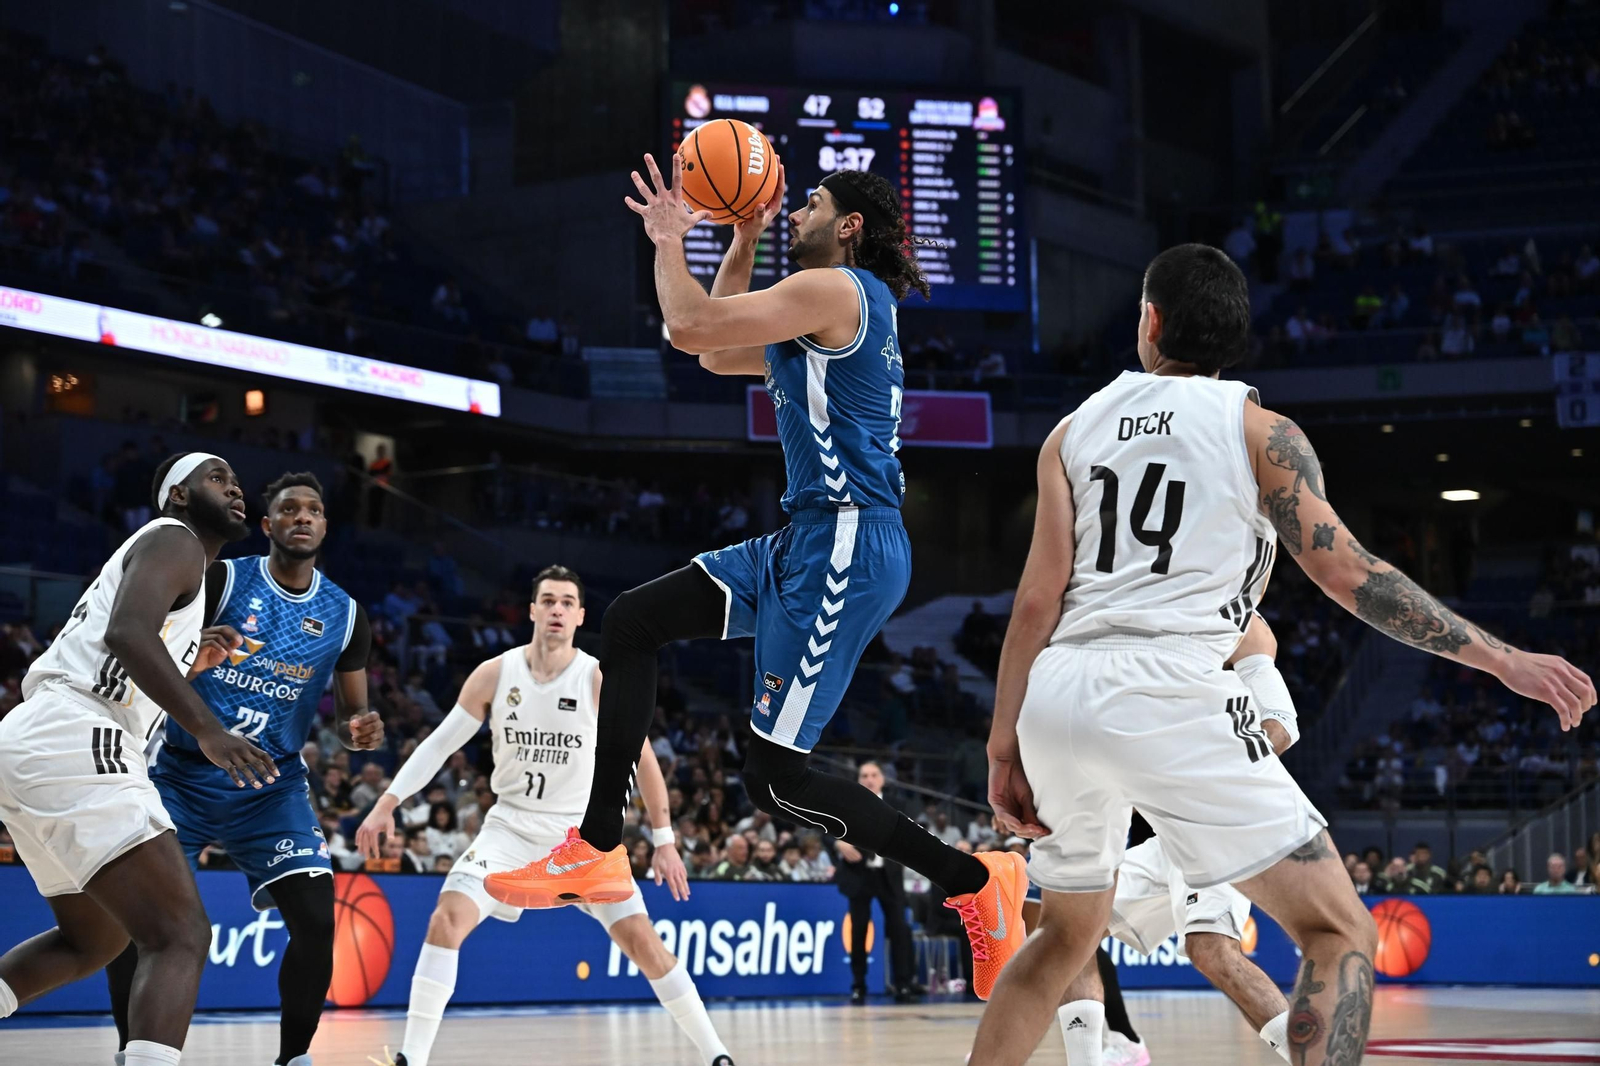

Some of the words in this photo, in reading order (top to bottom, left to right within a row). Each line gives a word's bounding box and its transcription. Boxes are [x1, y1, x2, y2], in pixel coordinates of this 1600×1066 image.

[804, 94, 832, 117] 47
[858, 97, 886, 120] 52
[819, 147, 875, 172] 8:37
[1118, 411, 1175, 441] DECK
[1090, 463, 1186, 575] 14
[224, 668, 299, 701] BURGOS
[230, 706, 270, 743] 22
[504, 727, 583, 748] Emirates
[516, 746, 531, 762] FLY
[532, 748, 570, 765] BETTER
[525, 771, 546, 800] 11
[267, 847, 314, 867] LEXUS
